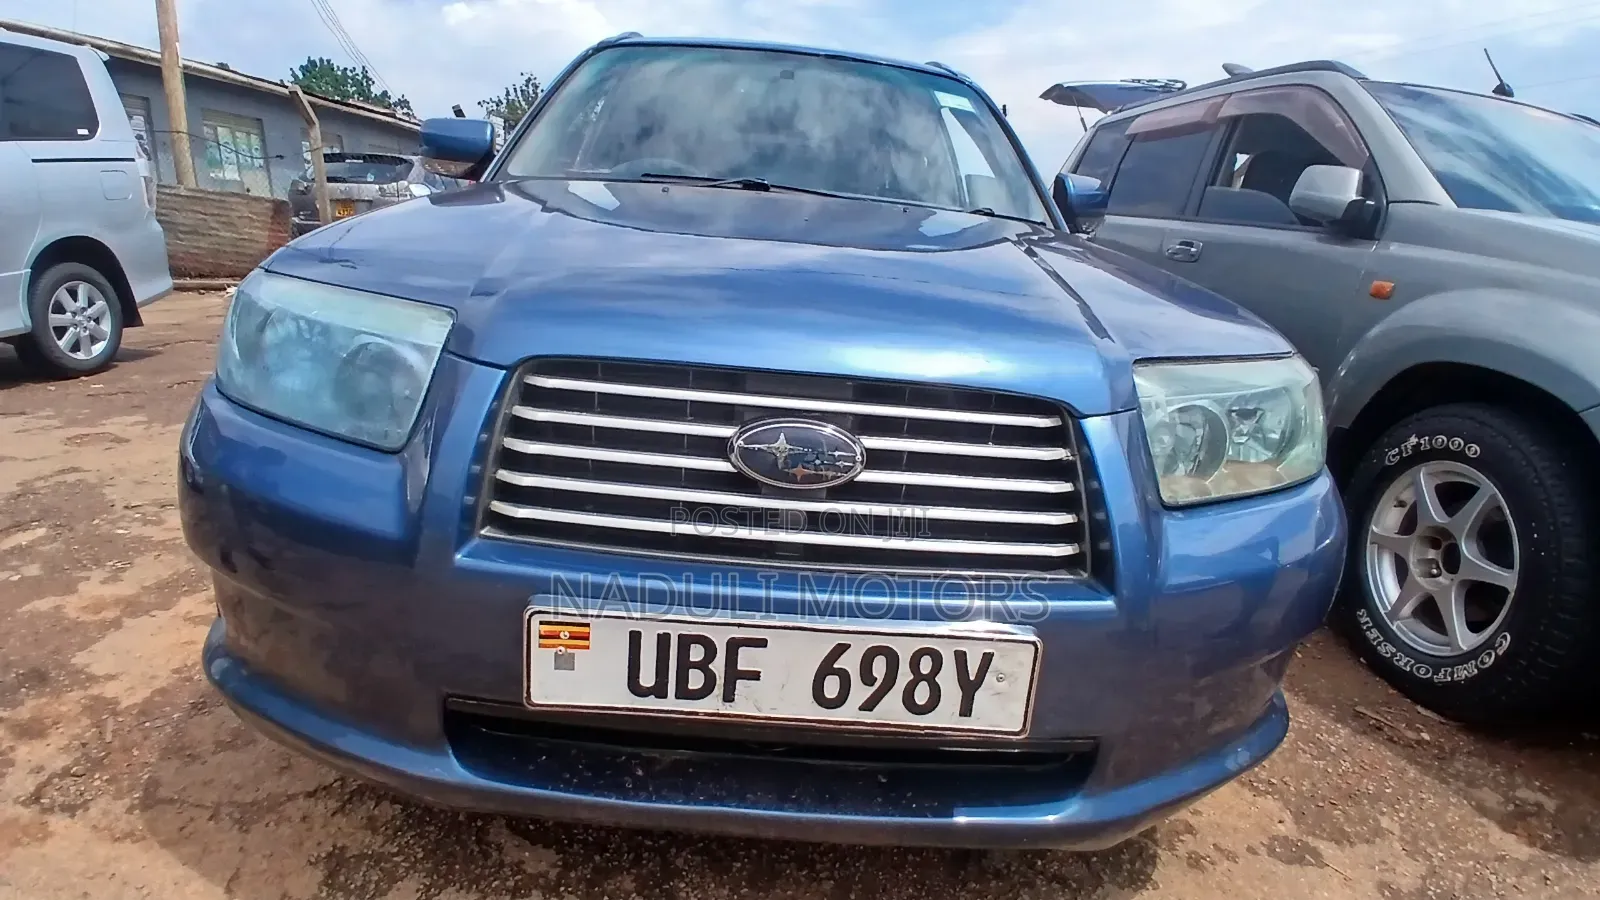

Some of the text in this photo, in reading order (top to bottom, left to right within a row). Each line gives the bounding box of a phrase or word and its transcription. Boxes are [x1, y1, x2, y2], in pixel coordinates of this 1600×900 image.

[1385, 433, 1481, 466] CF1000
[627, 629, 996, 719] UBF 698Y
